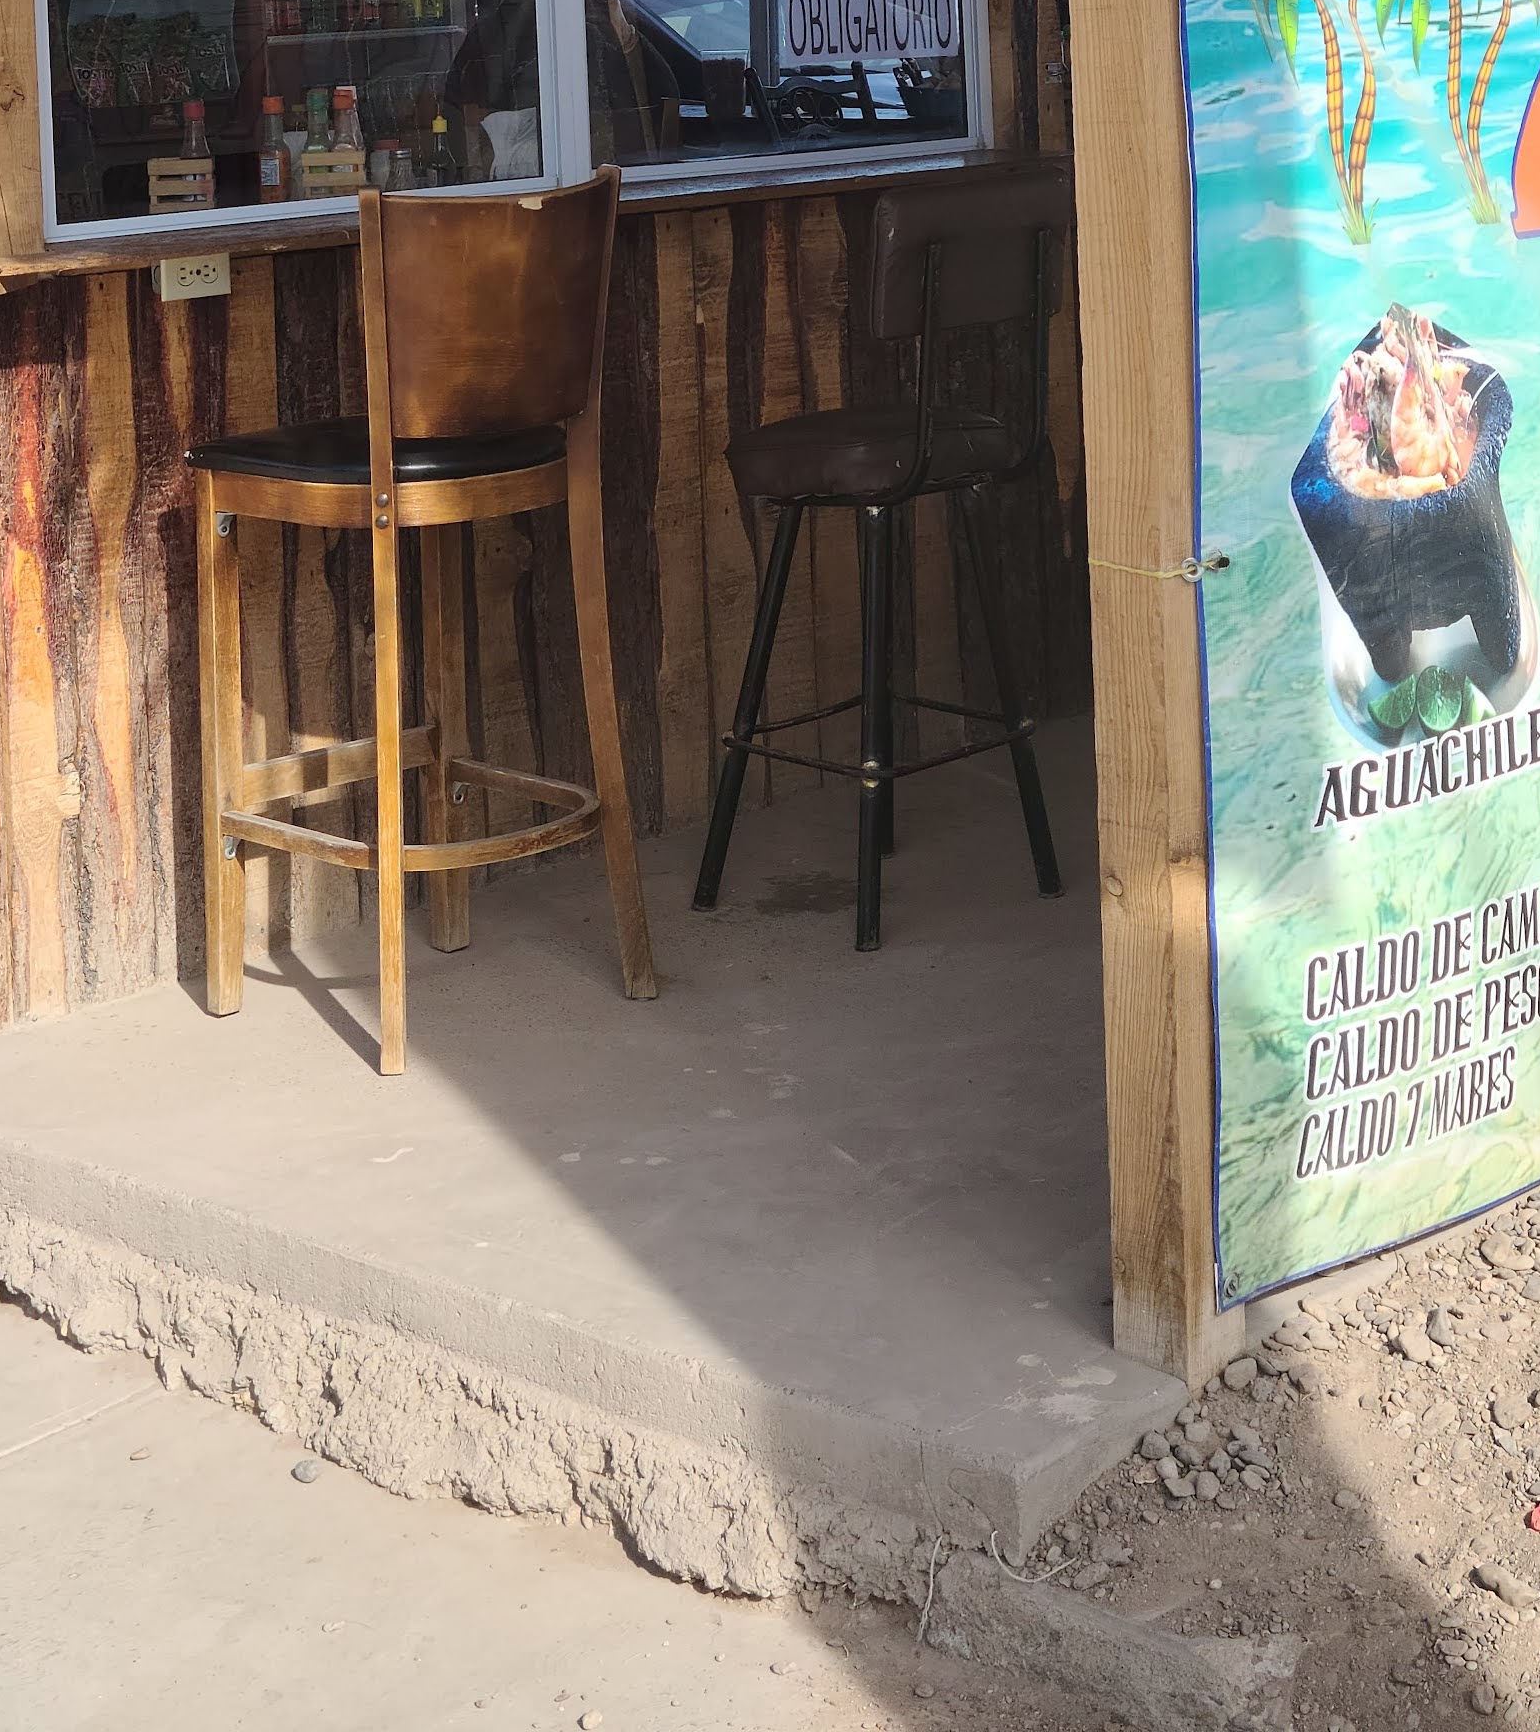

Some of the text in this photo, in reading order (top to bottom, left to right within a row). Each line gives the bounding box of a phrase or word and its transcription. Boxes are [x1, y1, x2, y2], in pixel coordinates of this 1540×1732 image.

[1307, 930, 1421, 1021] CALDO
[1430, 911, 1472, 985] DE
[1306, 1008, 1422, 1101] CALDO
[1431, 989, 1474, 1063] DE
[1296, 1045, 1516, 1179] CALDO 7 MARES
